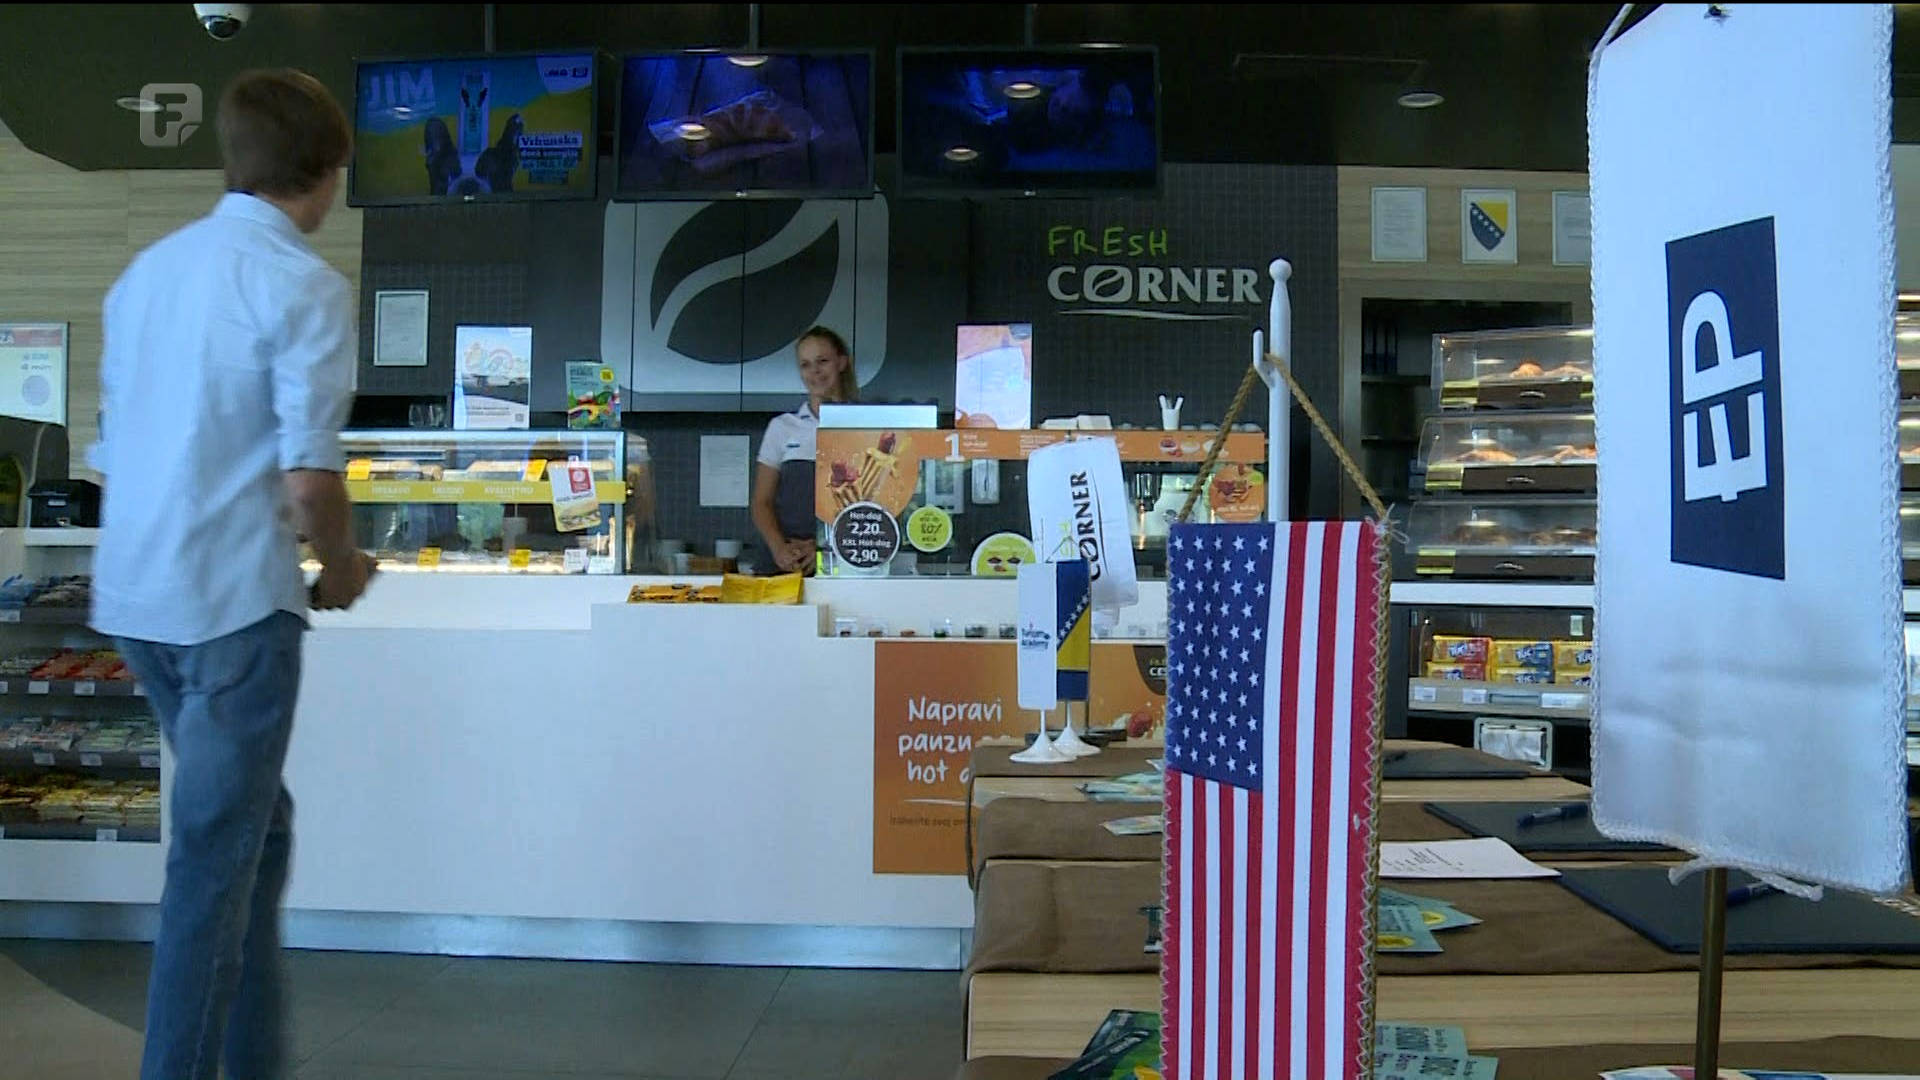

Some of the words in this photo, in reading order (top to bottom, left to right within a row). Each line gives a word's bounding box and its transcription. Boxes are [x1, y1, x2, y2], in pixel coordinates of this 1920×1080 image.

[1048, 224, 1169, 257] FRESH
[1046, 265, 1262, 304] CORNER
[850, 521, 880, 536] 2,20
[848, 548, 879, 563] 2,90
[908, 695, 1003, 727] Napravi
[897, 732, 972, 758] pauzu
[907, 758, 950, 785] hot
